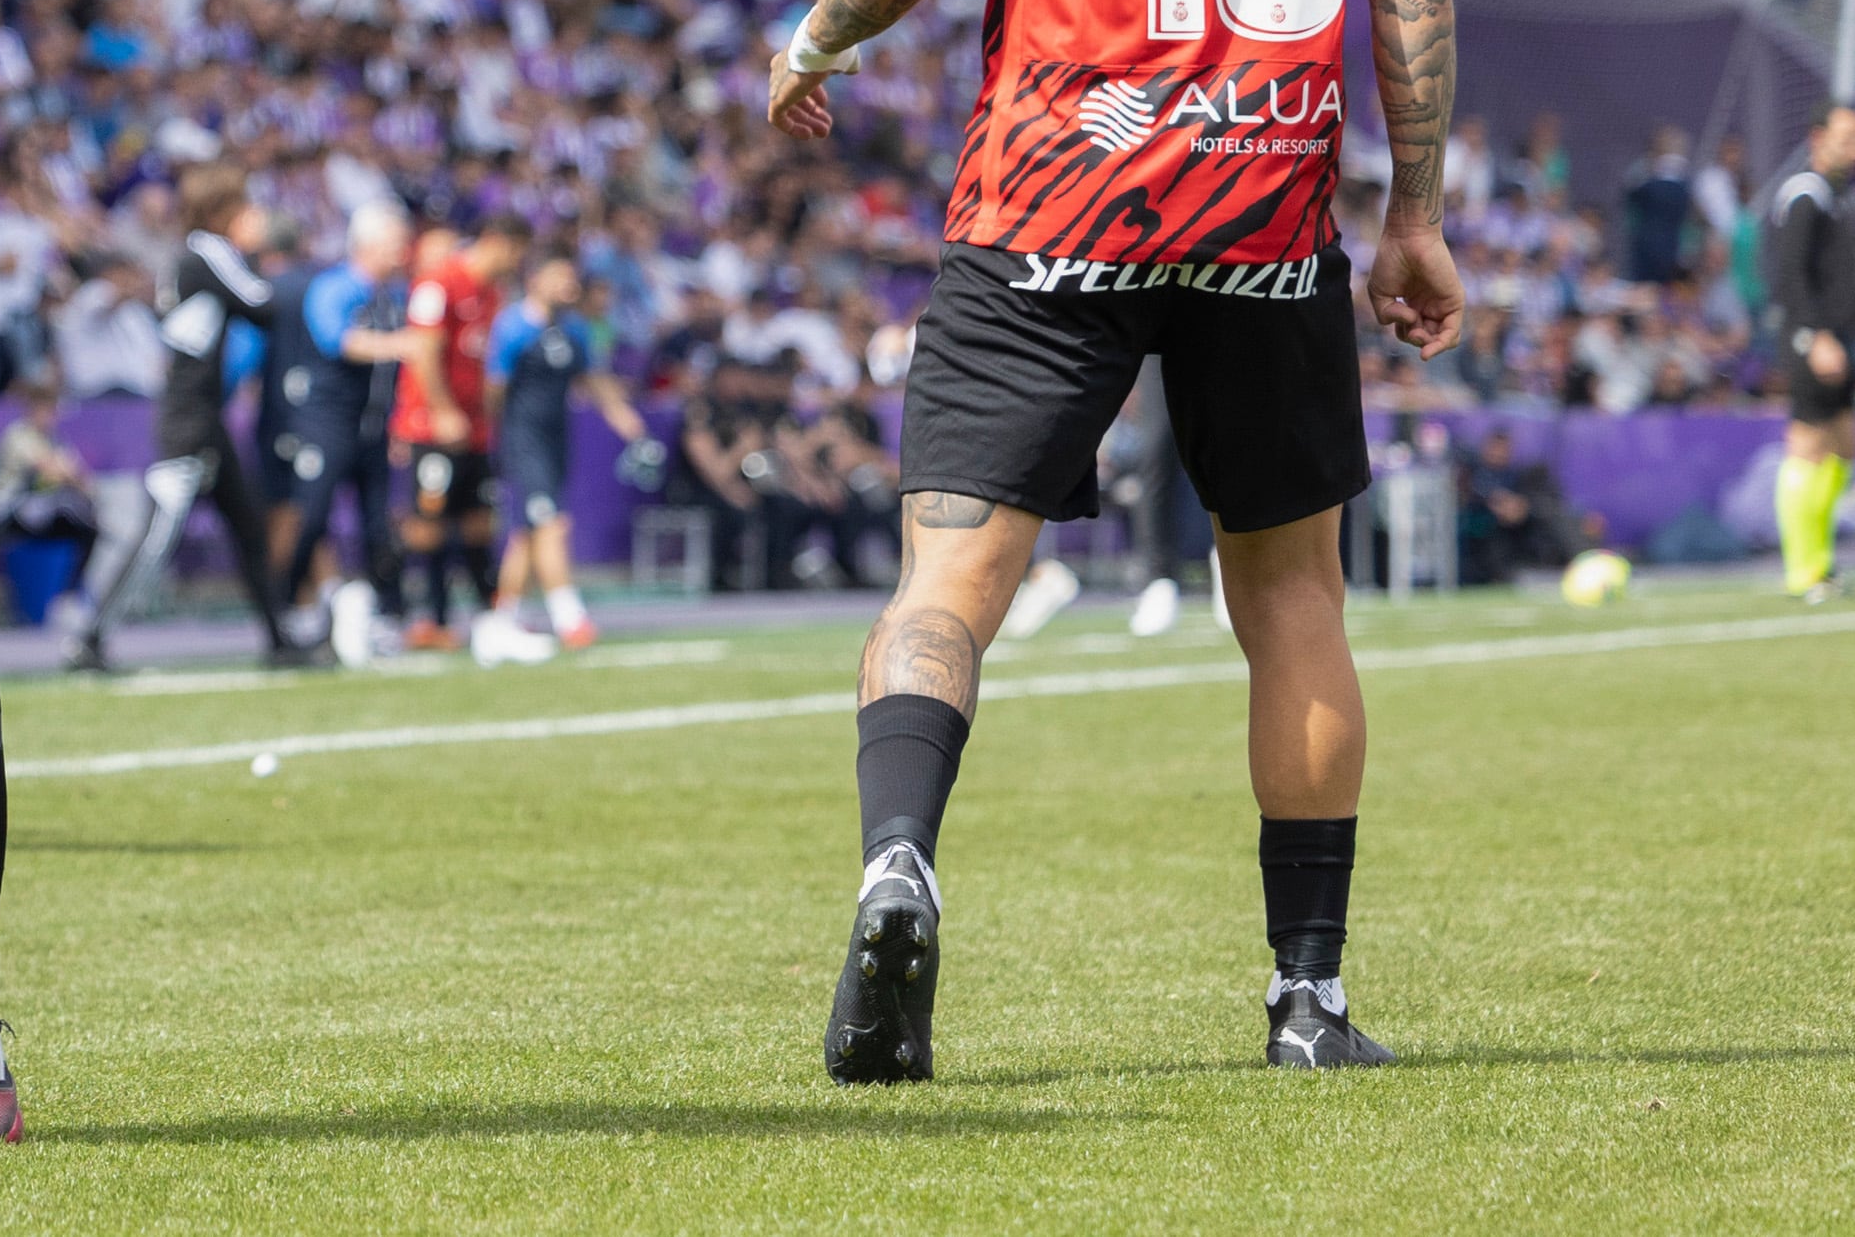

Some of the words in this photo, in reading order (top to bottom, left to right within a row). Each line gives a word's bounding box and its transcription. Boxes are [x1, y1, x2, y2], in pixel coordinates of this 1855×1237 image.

[1167, 78, 1343, 125] ALUA
[1190, 137, 1254, 154] HOTELS
[1256, 139, 1269, 153] &
[1271, 138, 1329, 155] RESORTS
